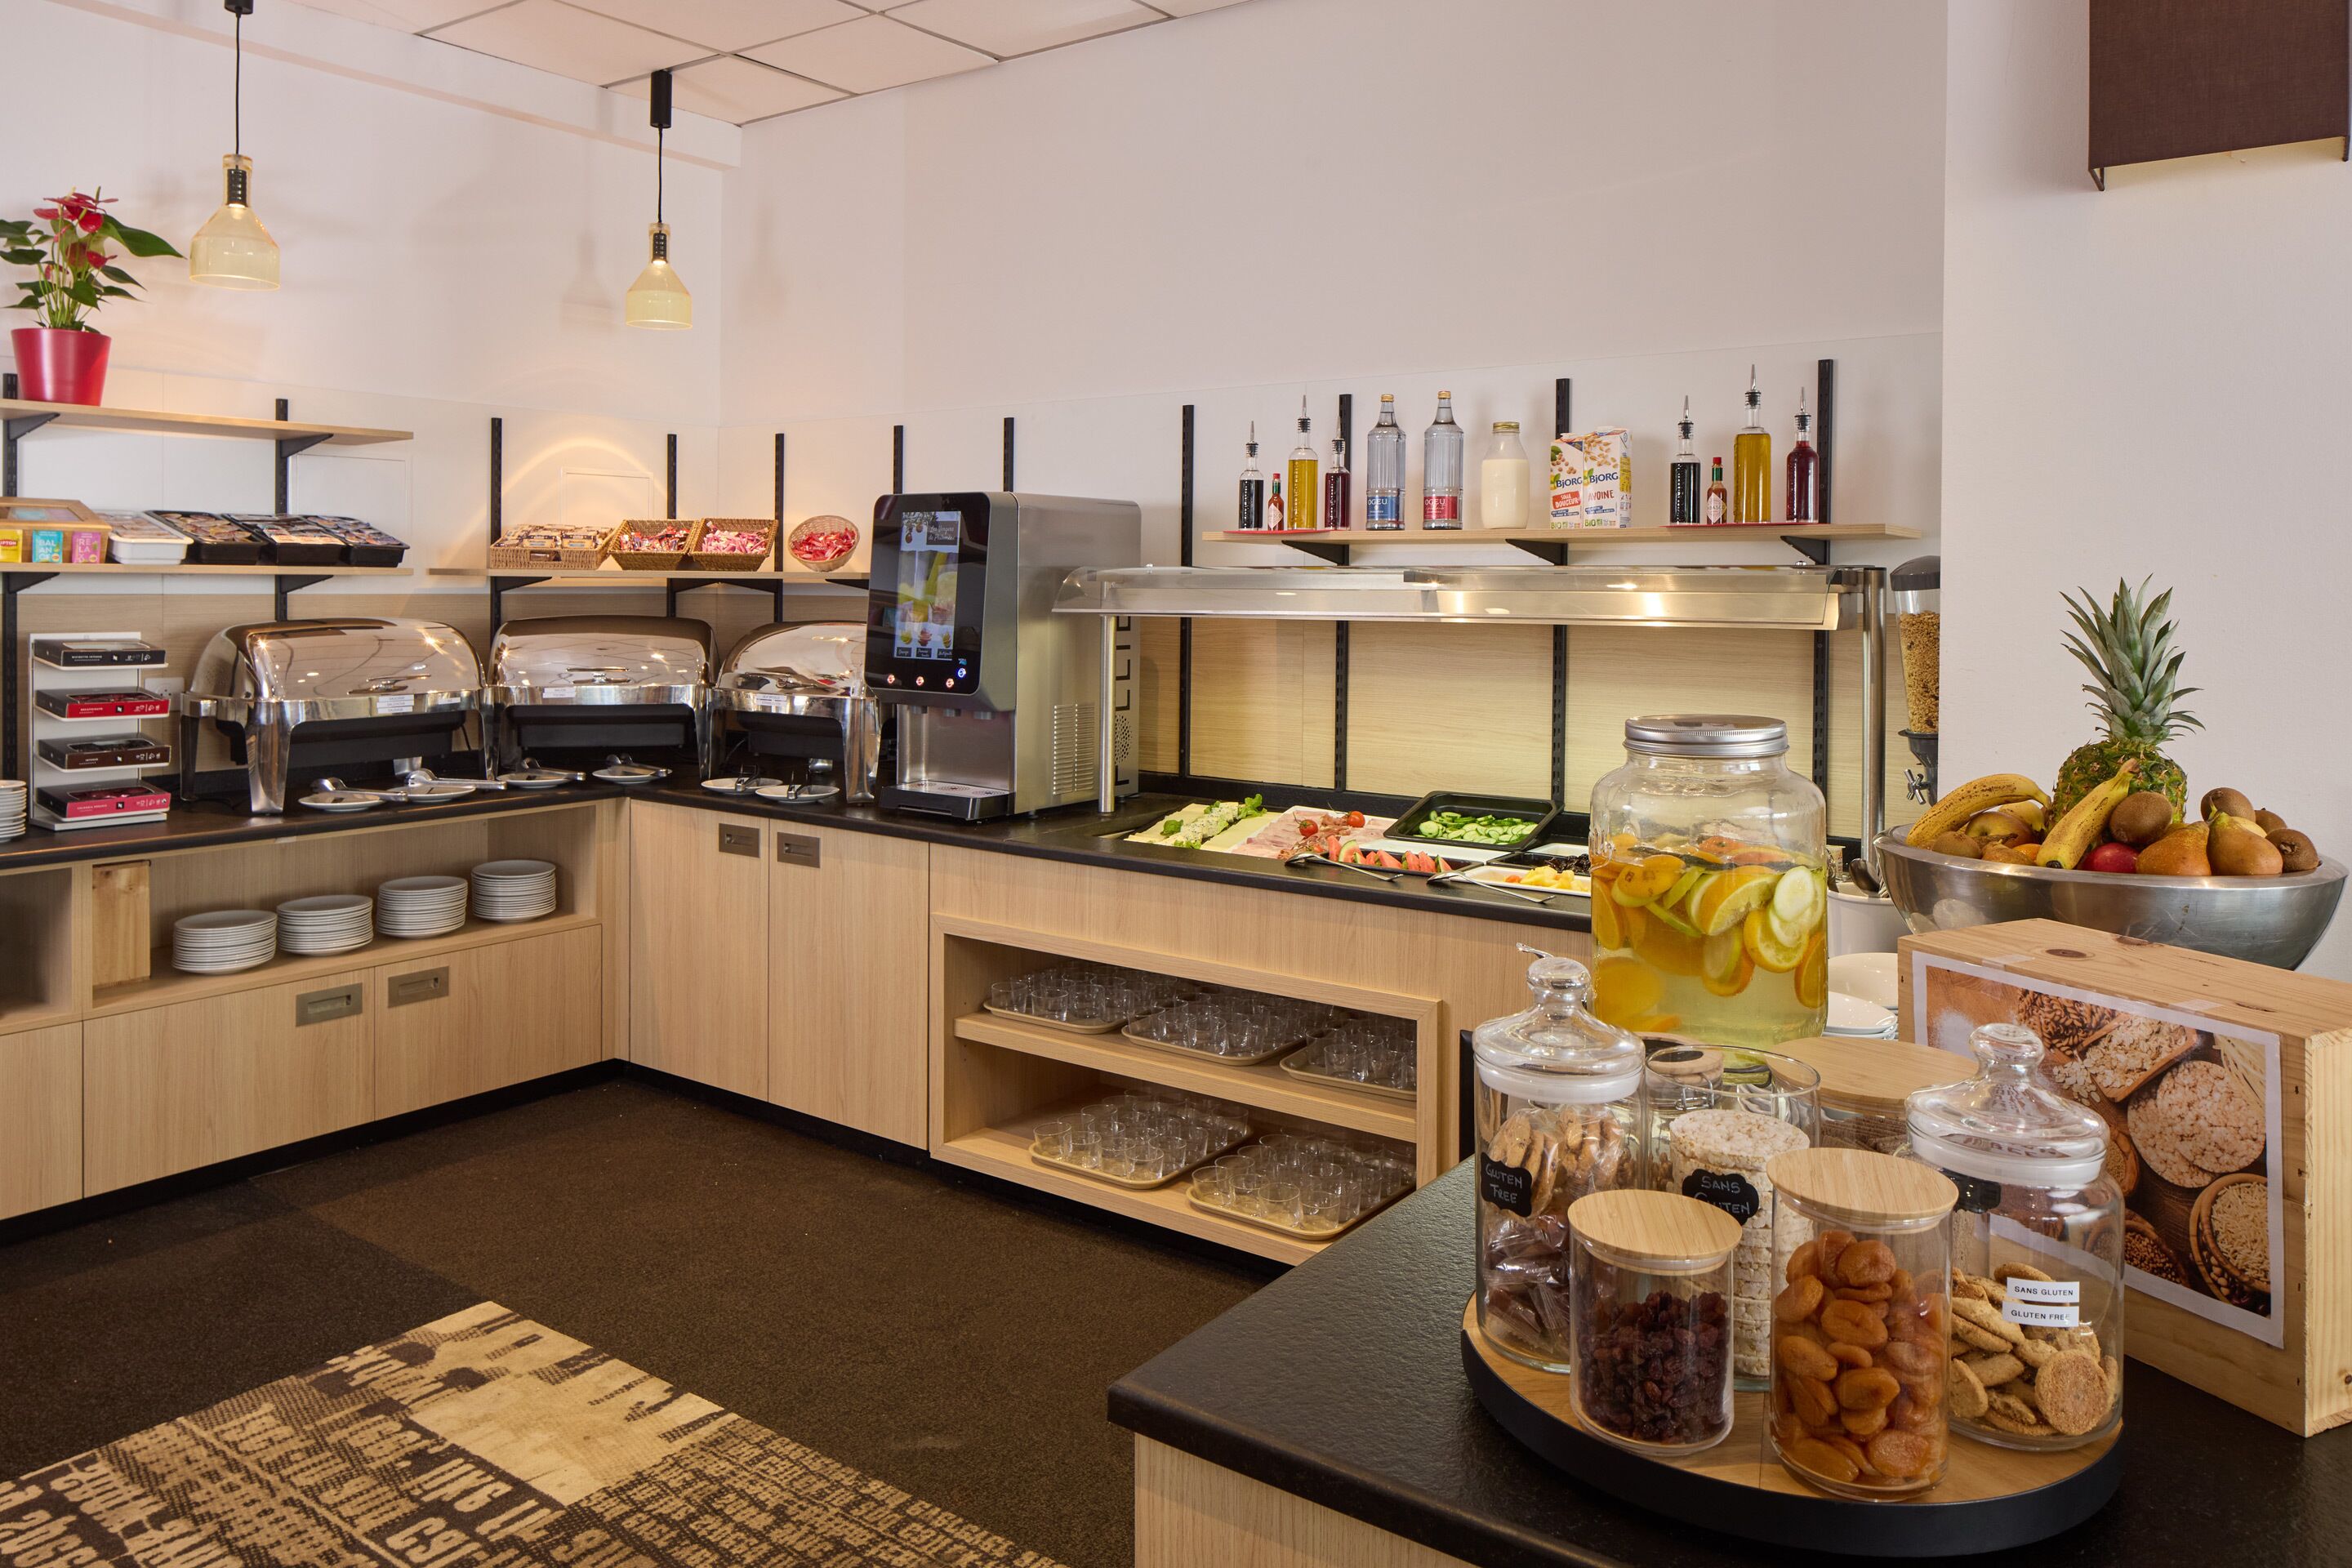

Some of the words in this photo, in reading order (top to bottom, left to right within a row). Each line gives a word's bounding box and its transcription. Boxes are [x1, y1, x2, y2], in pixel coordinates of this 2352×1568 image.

[1588, 490, 1614, 501] AVOINE
[1555, 497, 1579, 508] DOUCEUR
[1486, 1163, 1523, 1189] GLUTEN
[1701, 1176, 1741, 1193] SANS
[2014, 1285, 2038, 1295] SANS
[2011, 1309, 2047, 1320] GLUTEN
